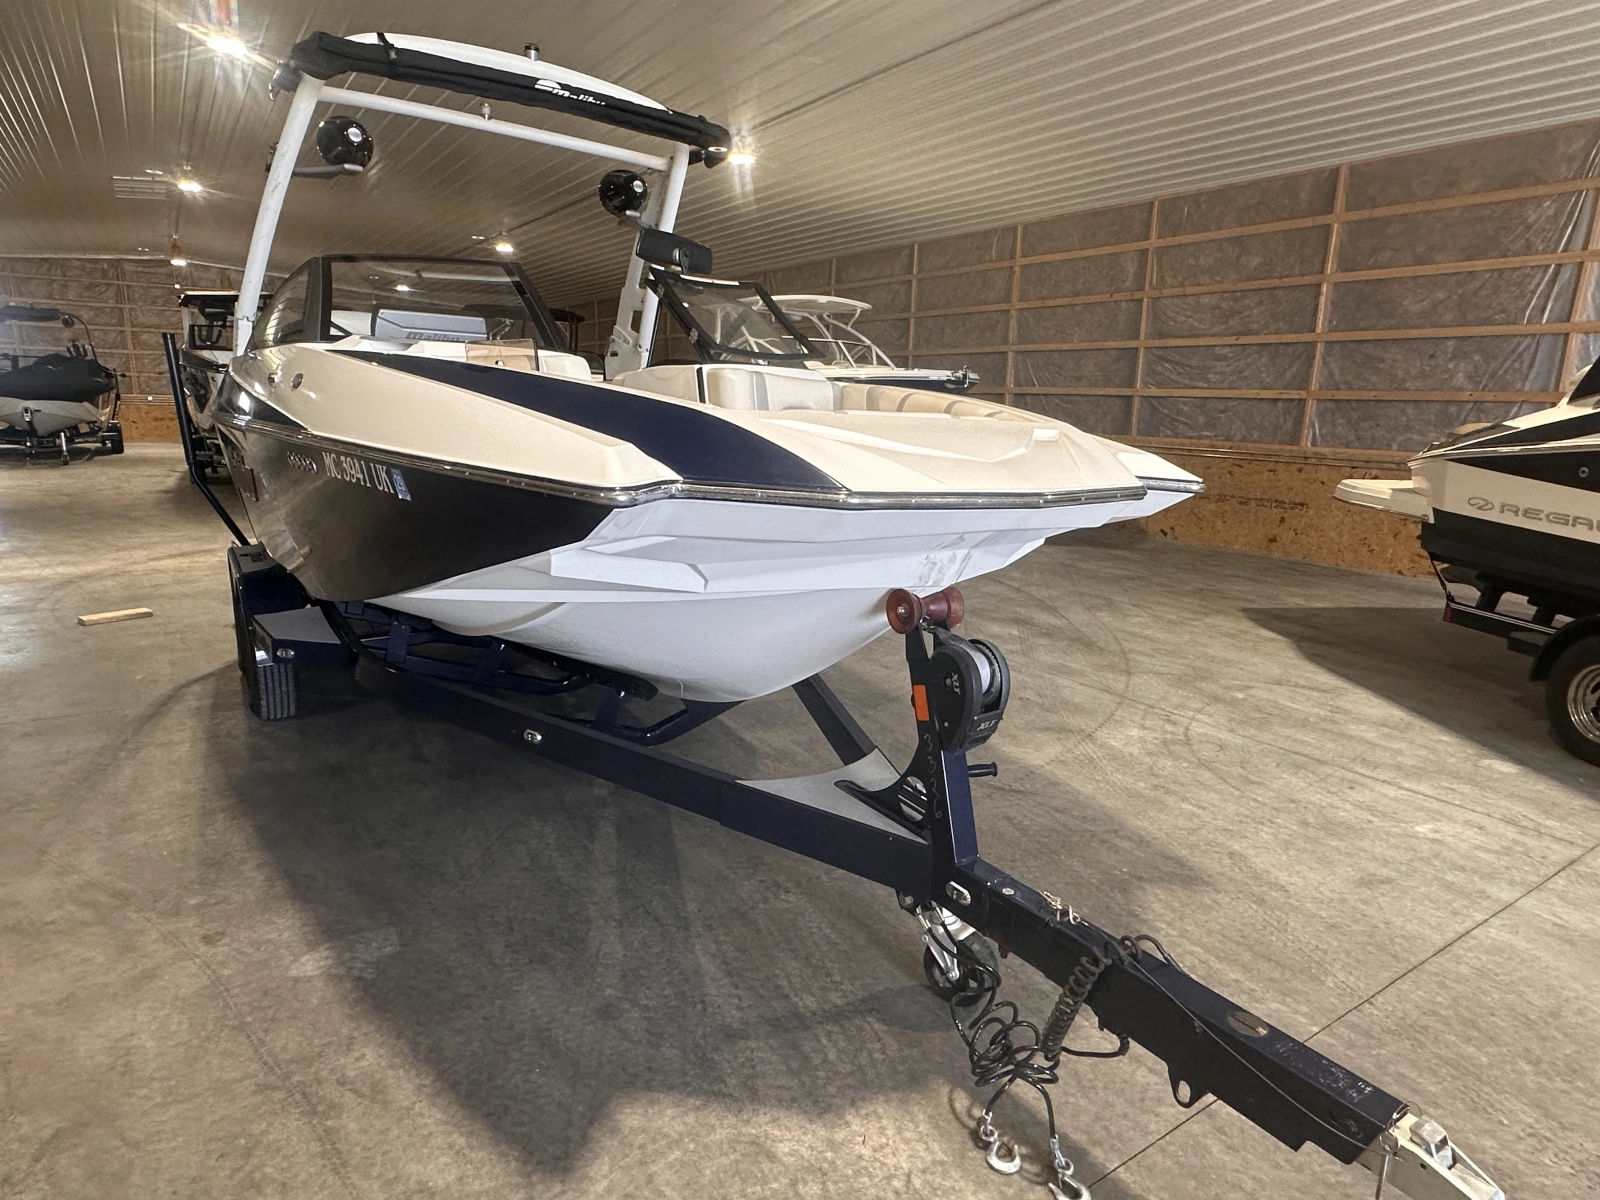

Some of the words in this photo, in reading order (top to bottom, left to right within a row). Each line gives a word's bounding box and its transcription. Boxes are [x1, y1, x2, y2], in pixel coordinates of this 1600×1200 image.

[322, 451, 341, 479] MC
[340, 455, 372, 487] 3941
[369, 462, 395, 494] UK
[1499, 502, 1600, 532] REGA
[977, 719, 998, 731] XLT
